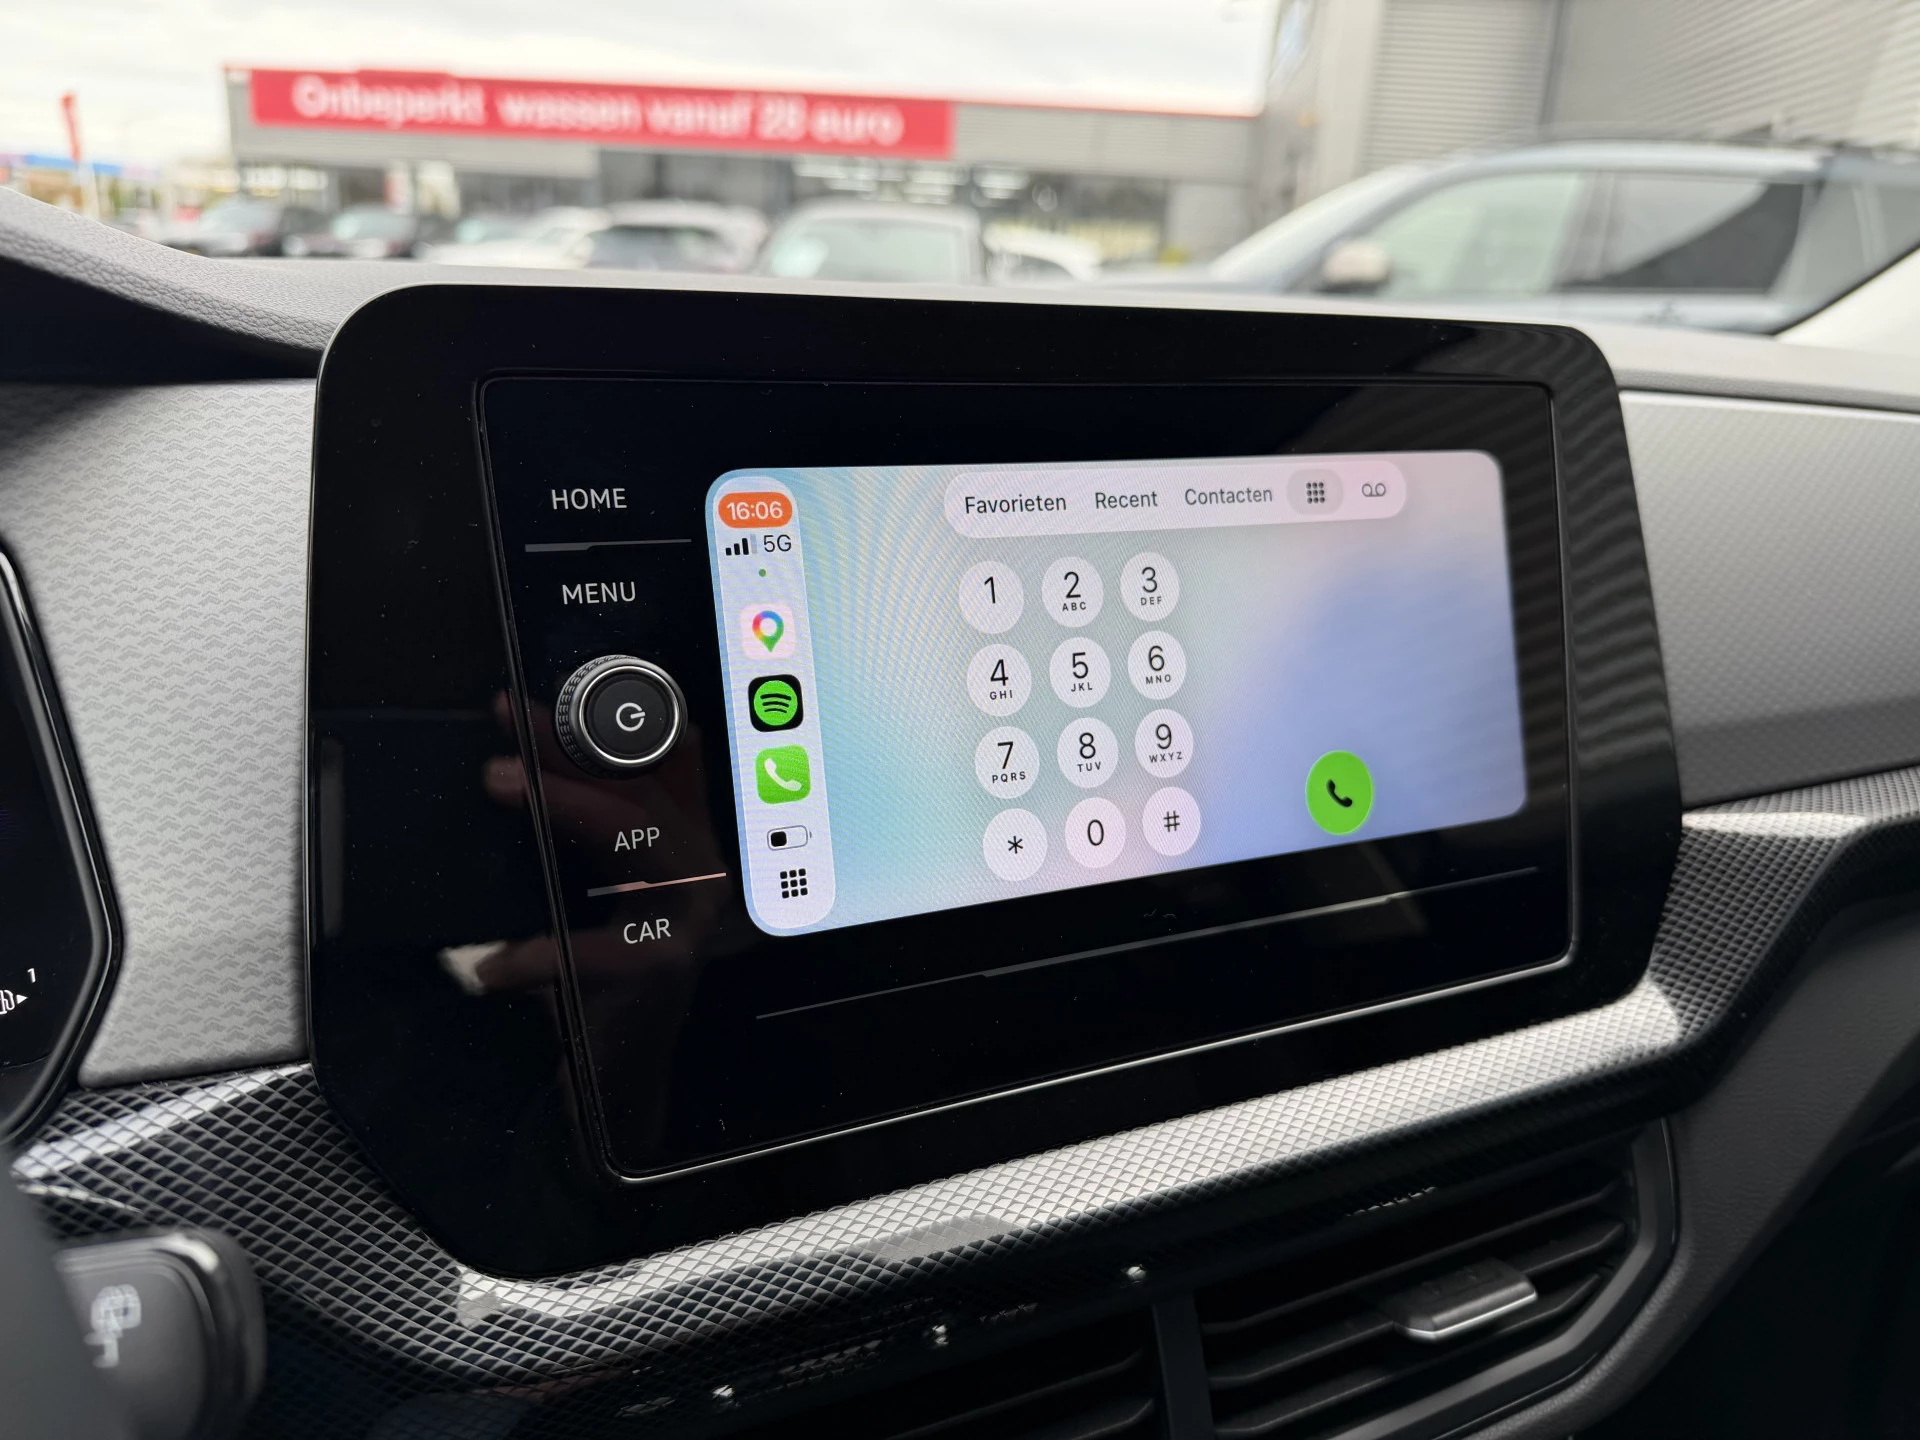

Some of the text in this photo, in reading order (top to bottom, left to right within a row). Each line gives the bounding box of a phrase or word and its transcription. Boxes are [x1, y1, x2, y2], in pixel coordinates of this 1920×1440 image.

[293, 76, 486, 130] Onbeperkt
[498, 92, 643, 131] wassen
[646, 92, 751, 136] vanaf
[810, 102, 905, 147] euro
[552, 488, 627, 510] HOME
[965, 494, 1067, 515] Favorieten
[1095, 491, 1157, 509] Recent
[1184, 486, 1273, 506] Contacten
[727, 501, 783, 520] 16:06
[763, 535, 792, 553] 5G
[984, 576, 996, 604] 1
[1064, 571, 1082, 600] 2
[1141, 566, 1158, 593] 3
[562, 581, 637, 605] MENU
[1141, 596, 1162, 605] DEF
[1062, 601, 1087, 612] ABC
[1071, 652, 1089, 680] 5
[1147, 645, 1165, 671] 6
[990, 659, 1009, 688] 4
[1145, 674, 1172, 685] MNO
[989, 689, 1013, 700] GHI
[1071, 682, 1093, 692] JKL
[1079, 732, 1096, 760] 8
[1155, 723, 1172, 750] 9
[997, 741, 1014, 770] 7
[1077, 761, 1101, 773] TUV
[1149, 751, 1183, 763] WXYZ
[992, 771, 1026, 784] PQRS
[614, 826, 661, 852] APP
[1087, 819, 1105, 846] 0
[623, 918, 672, 944] CAR
